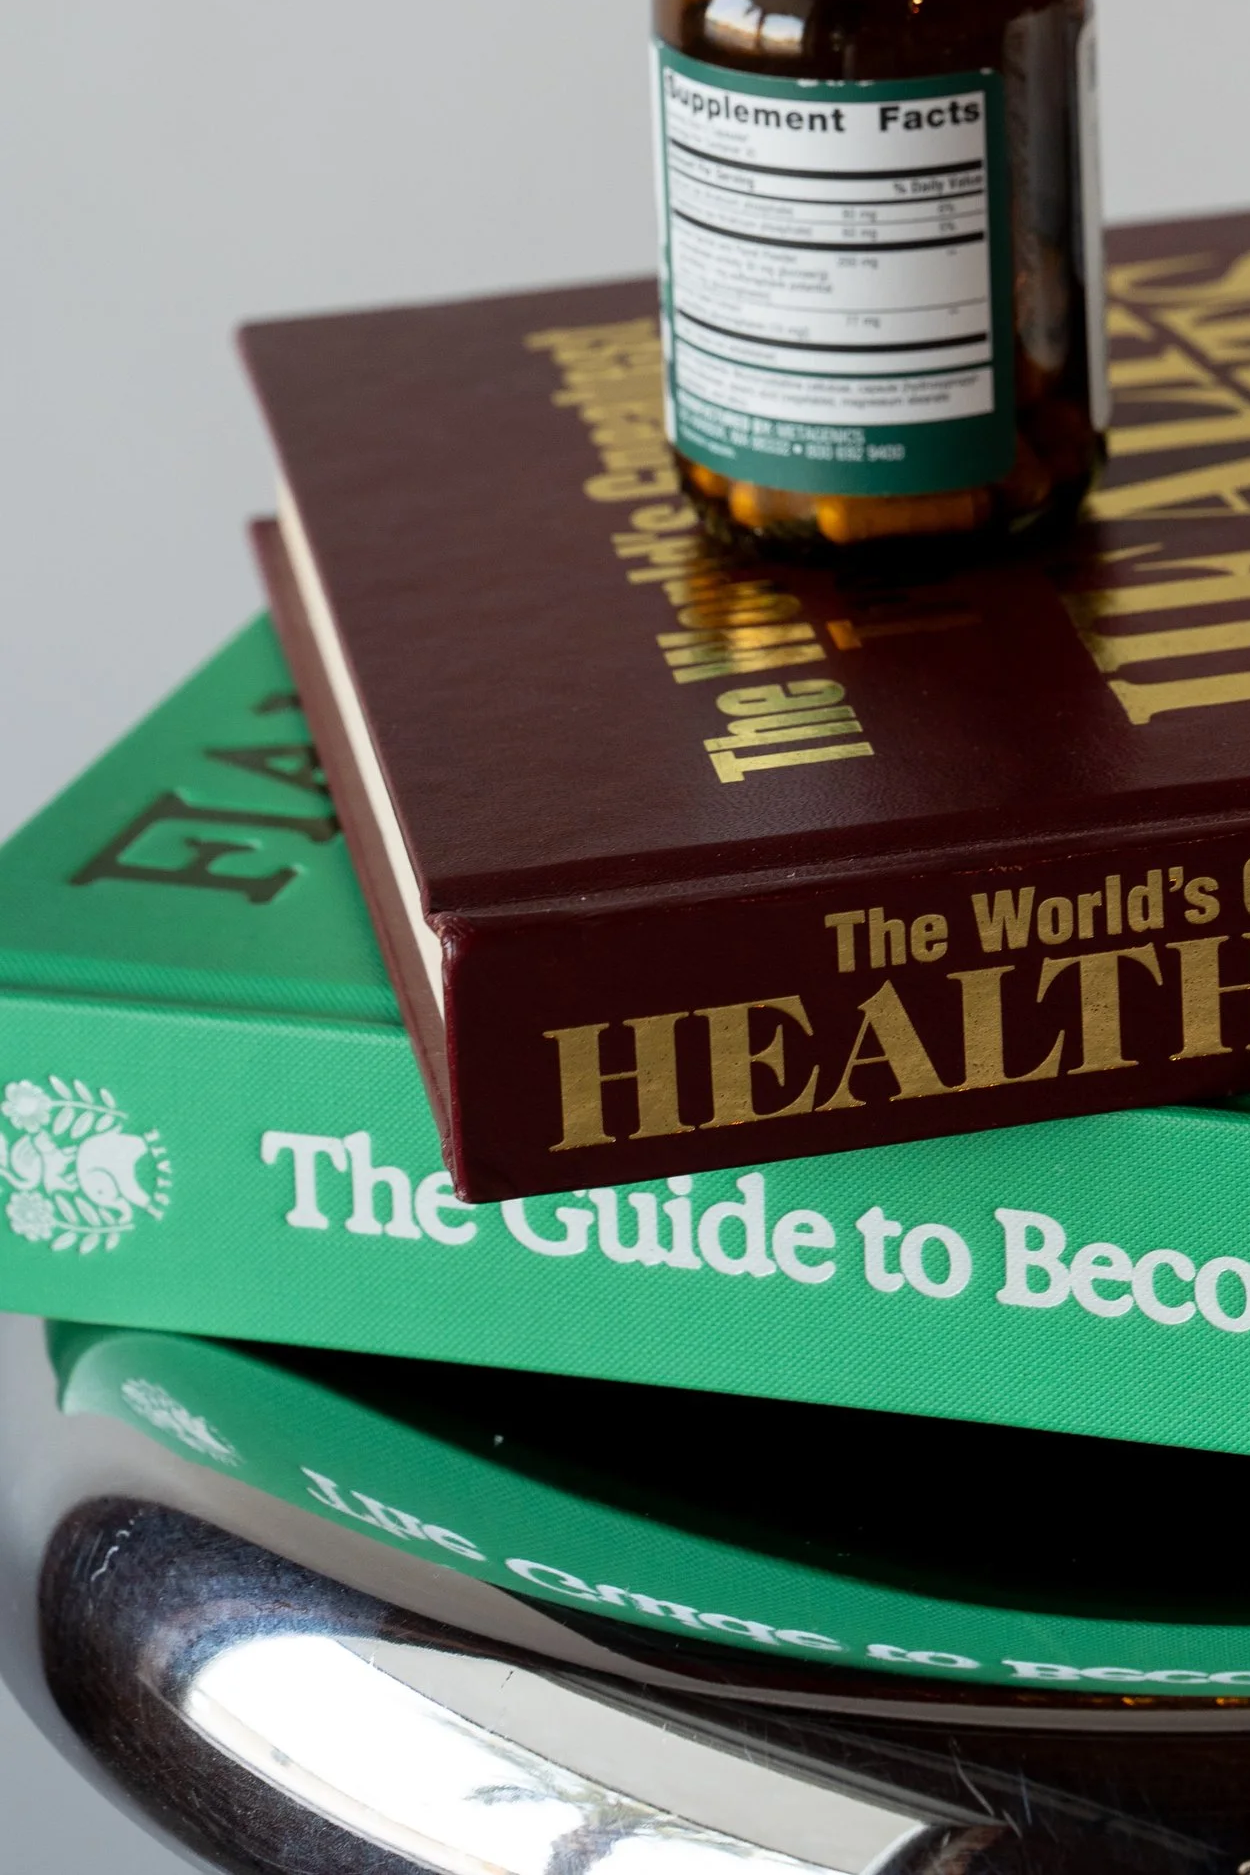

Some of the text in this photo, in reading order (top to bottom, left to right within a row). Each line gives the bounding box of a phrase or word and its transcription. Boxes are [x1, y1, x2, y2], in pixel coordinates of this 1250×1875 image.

[664, 74, 845, 132] Supplement
[879, 101, 980, 131] Facts
[910, 178, 943, 196] Daily
[703, 677, 876, 784] The
[825, 902, 949, 973] The
[970, 865, 1222, 955] World's
[259, 1129, 478, 1246] The
[500, 1170, 838, 1286] Guide
[854, 1205, 973, 1300] to
